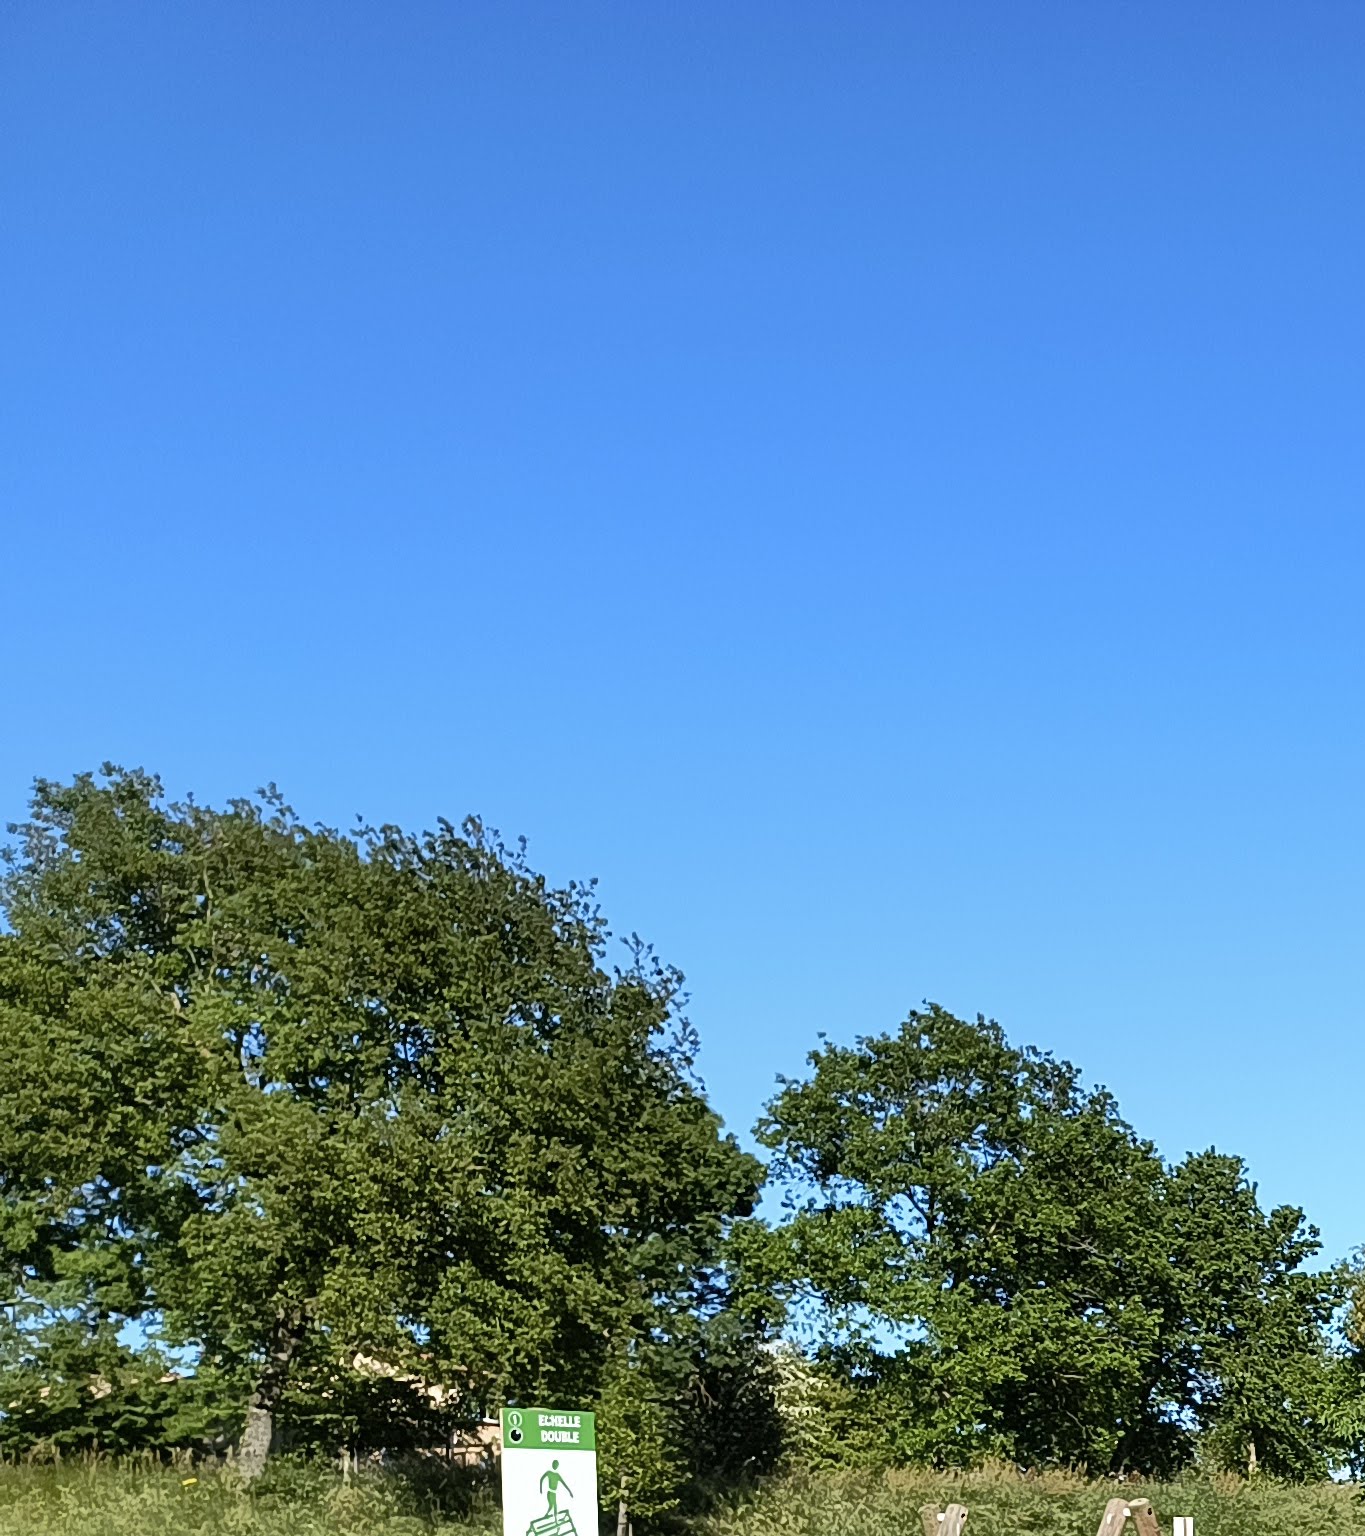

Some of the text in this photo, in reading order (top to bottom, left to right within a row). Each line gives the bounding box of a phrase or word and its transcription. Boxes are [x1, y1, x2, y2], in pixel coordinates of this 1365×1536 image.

[512, 1414, 518, 1426] 1
[538, 1414, 581, 1428] ECHELLE
[540, 1429, 580, 1444] DOUBLE
